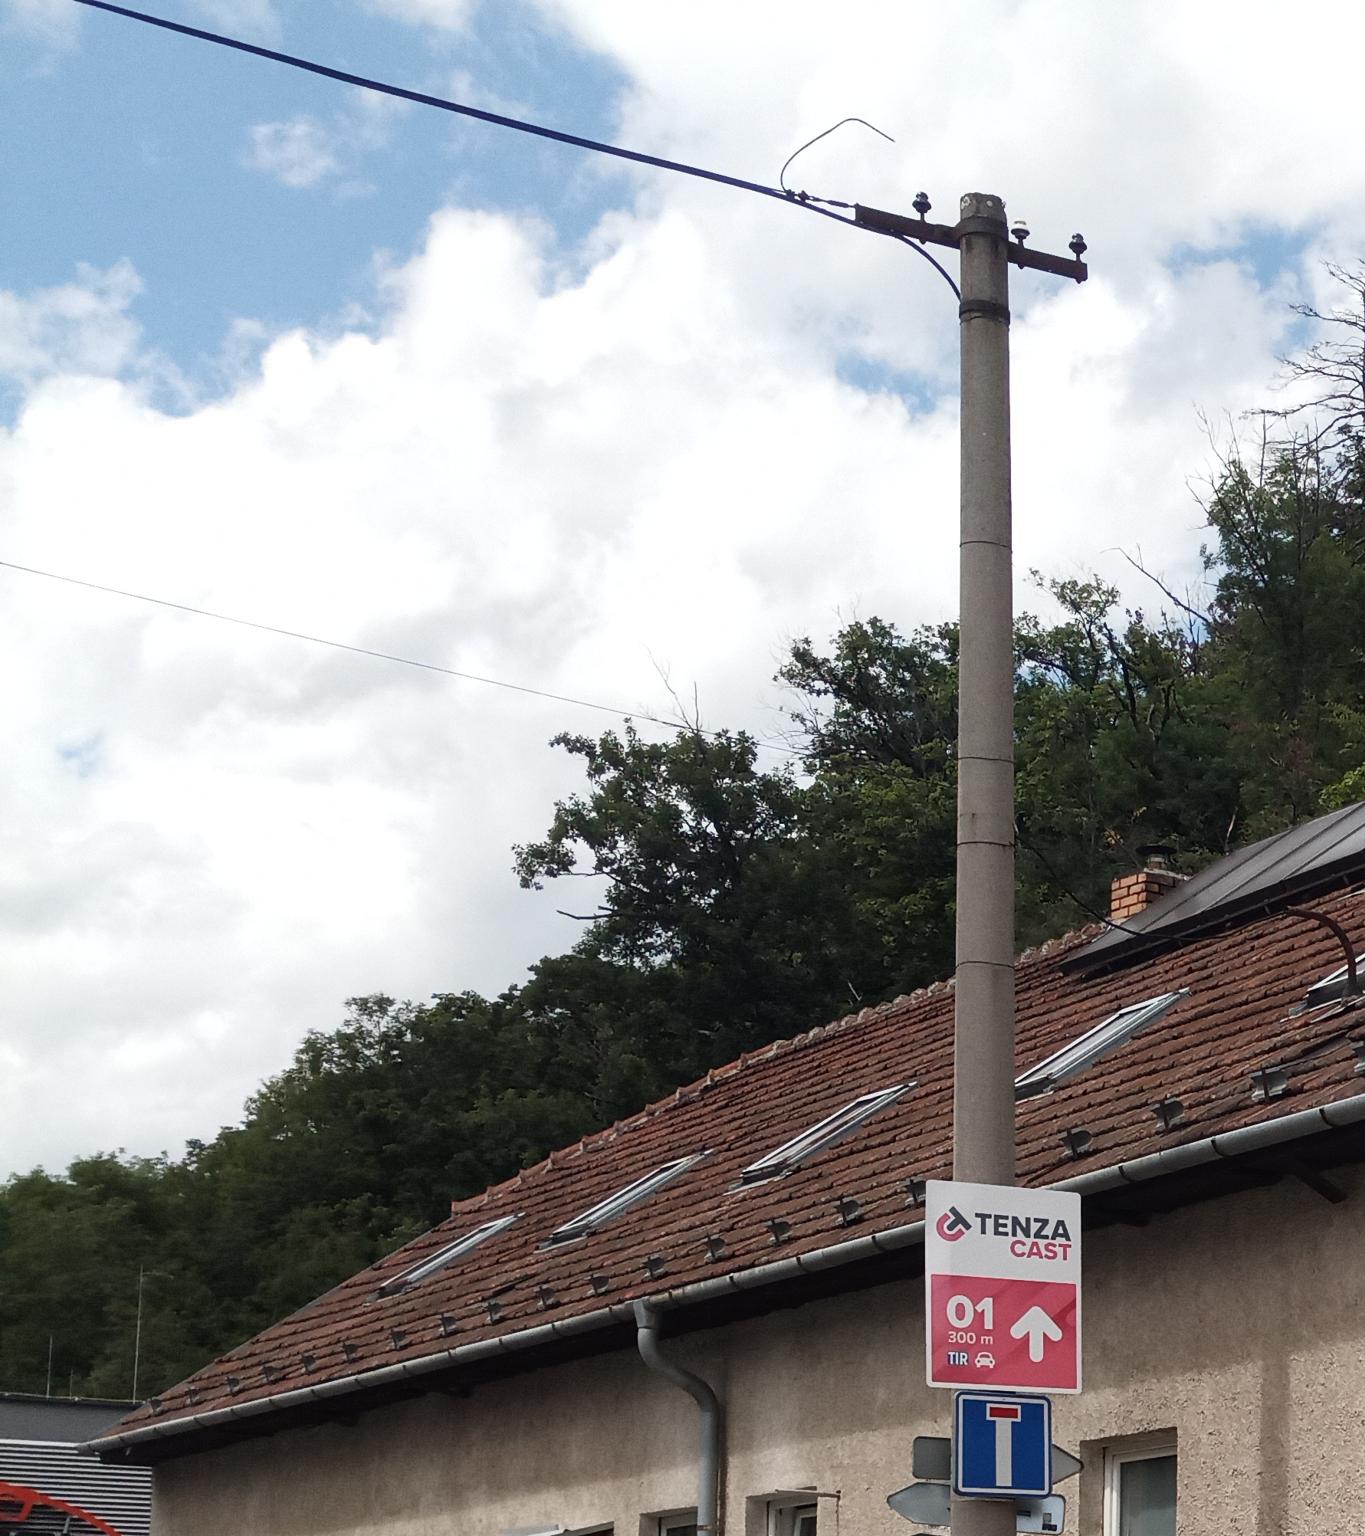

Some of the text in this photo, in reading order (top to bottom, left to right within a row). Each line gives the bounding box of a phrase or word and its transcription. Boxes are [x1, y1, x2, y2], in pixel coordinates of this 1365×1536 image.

[975, 1212, 1071, 1242] TENZA
[1010, 1239, 1072, 1261] CAST
[946, 1295, 993, 1330] 01
[948, 1331, 993, 1345] 300 m
[948, 1351, 969, 1365] TIR
